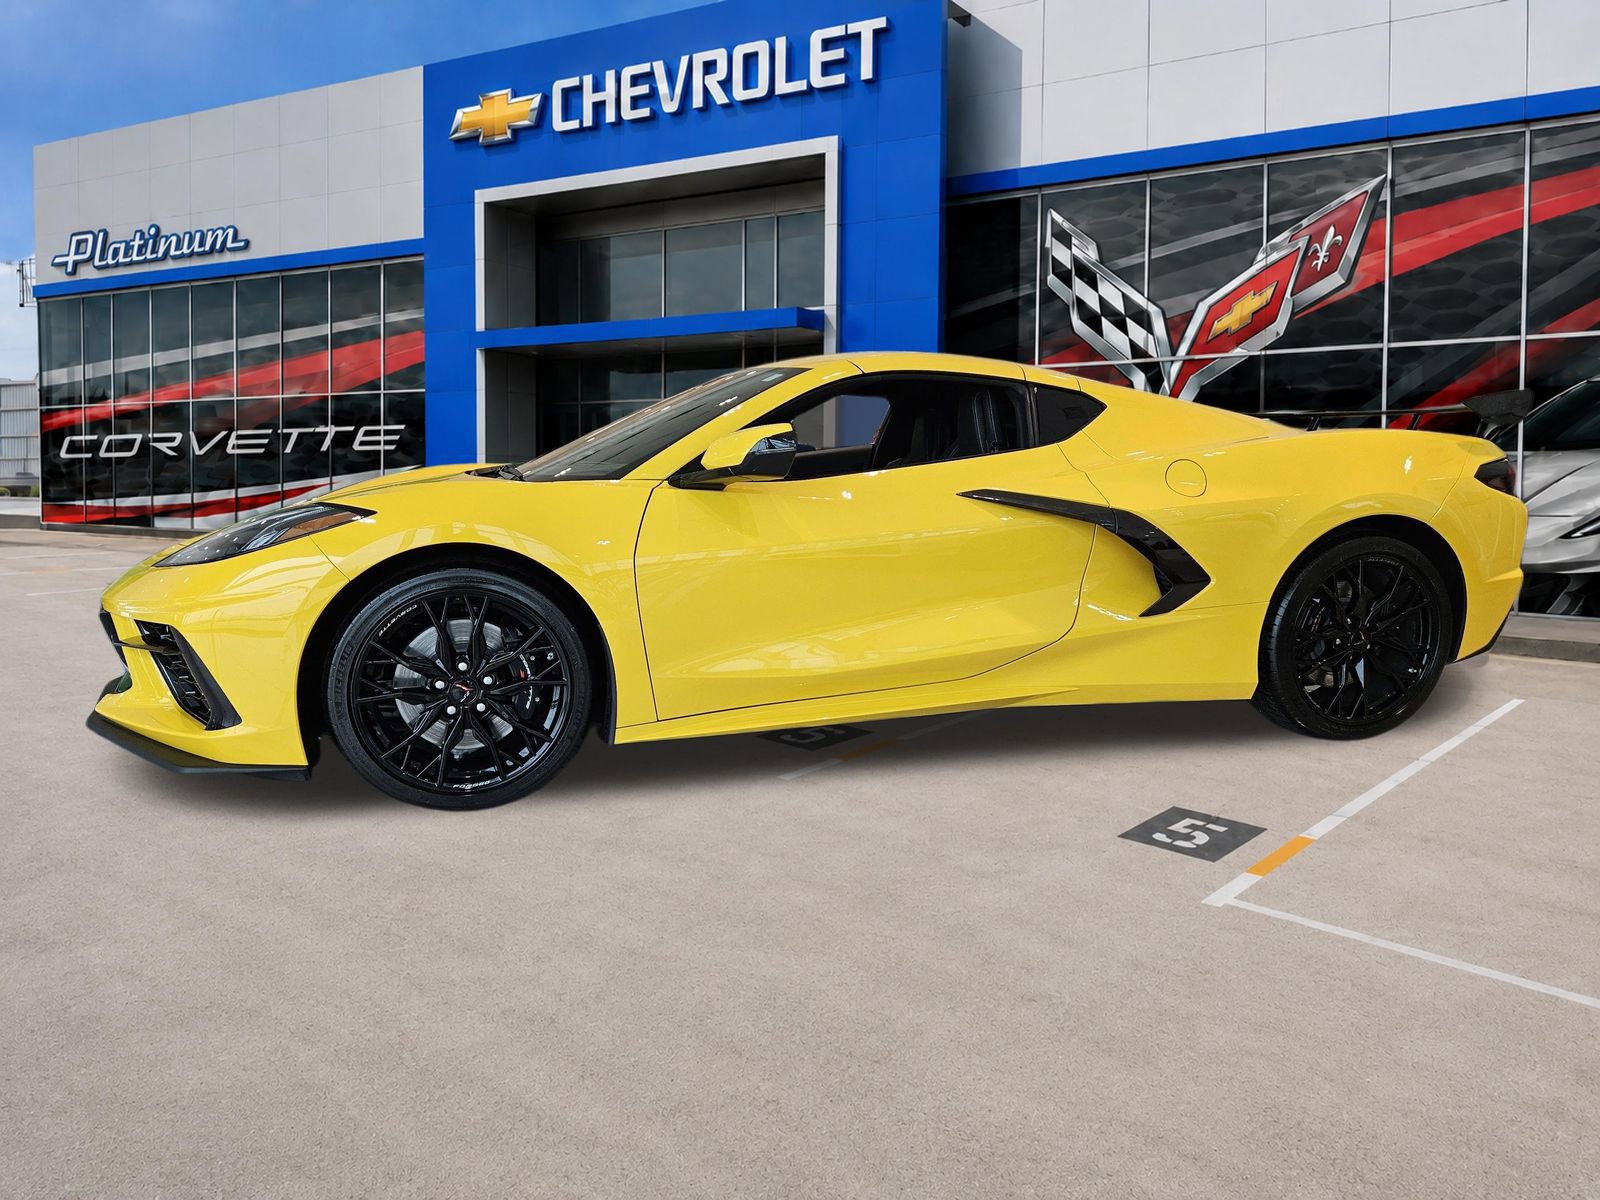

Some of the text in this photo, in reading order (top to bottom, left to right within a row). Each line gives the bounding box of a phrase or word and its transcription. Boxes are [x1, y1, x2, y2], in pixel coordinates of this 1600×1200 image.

[551, 16, 887, 133] CHEVROLET
[52, 224, 249, 275] Platinum
[59, 424, 406, 459] CORVETTE
[1151, 817, 1229, 849] 5
